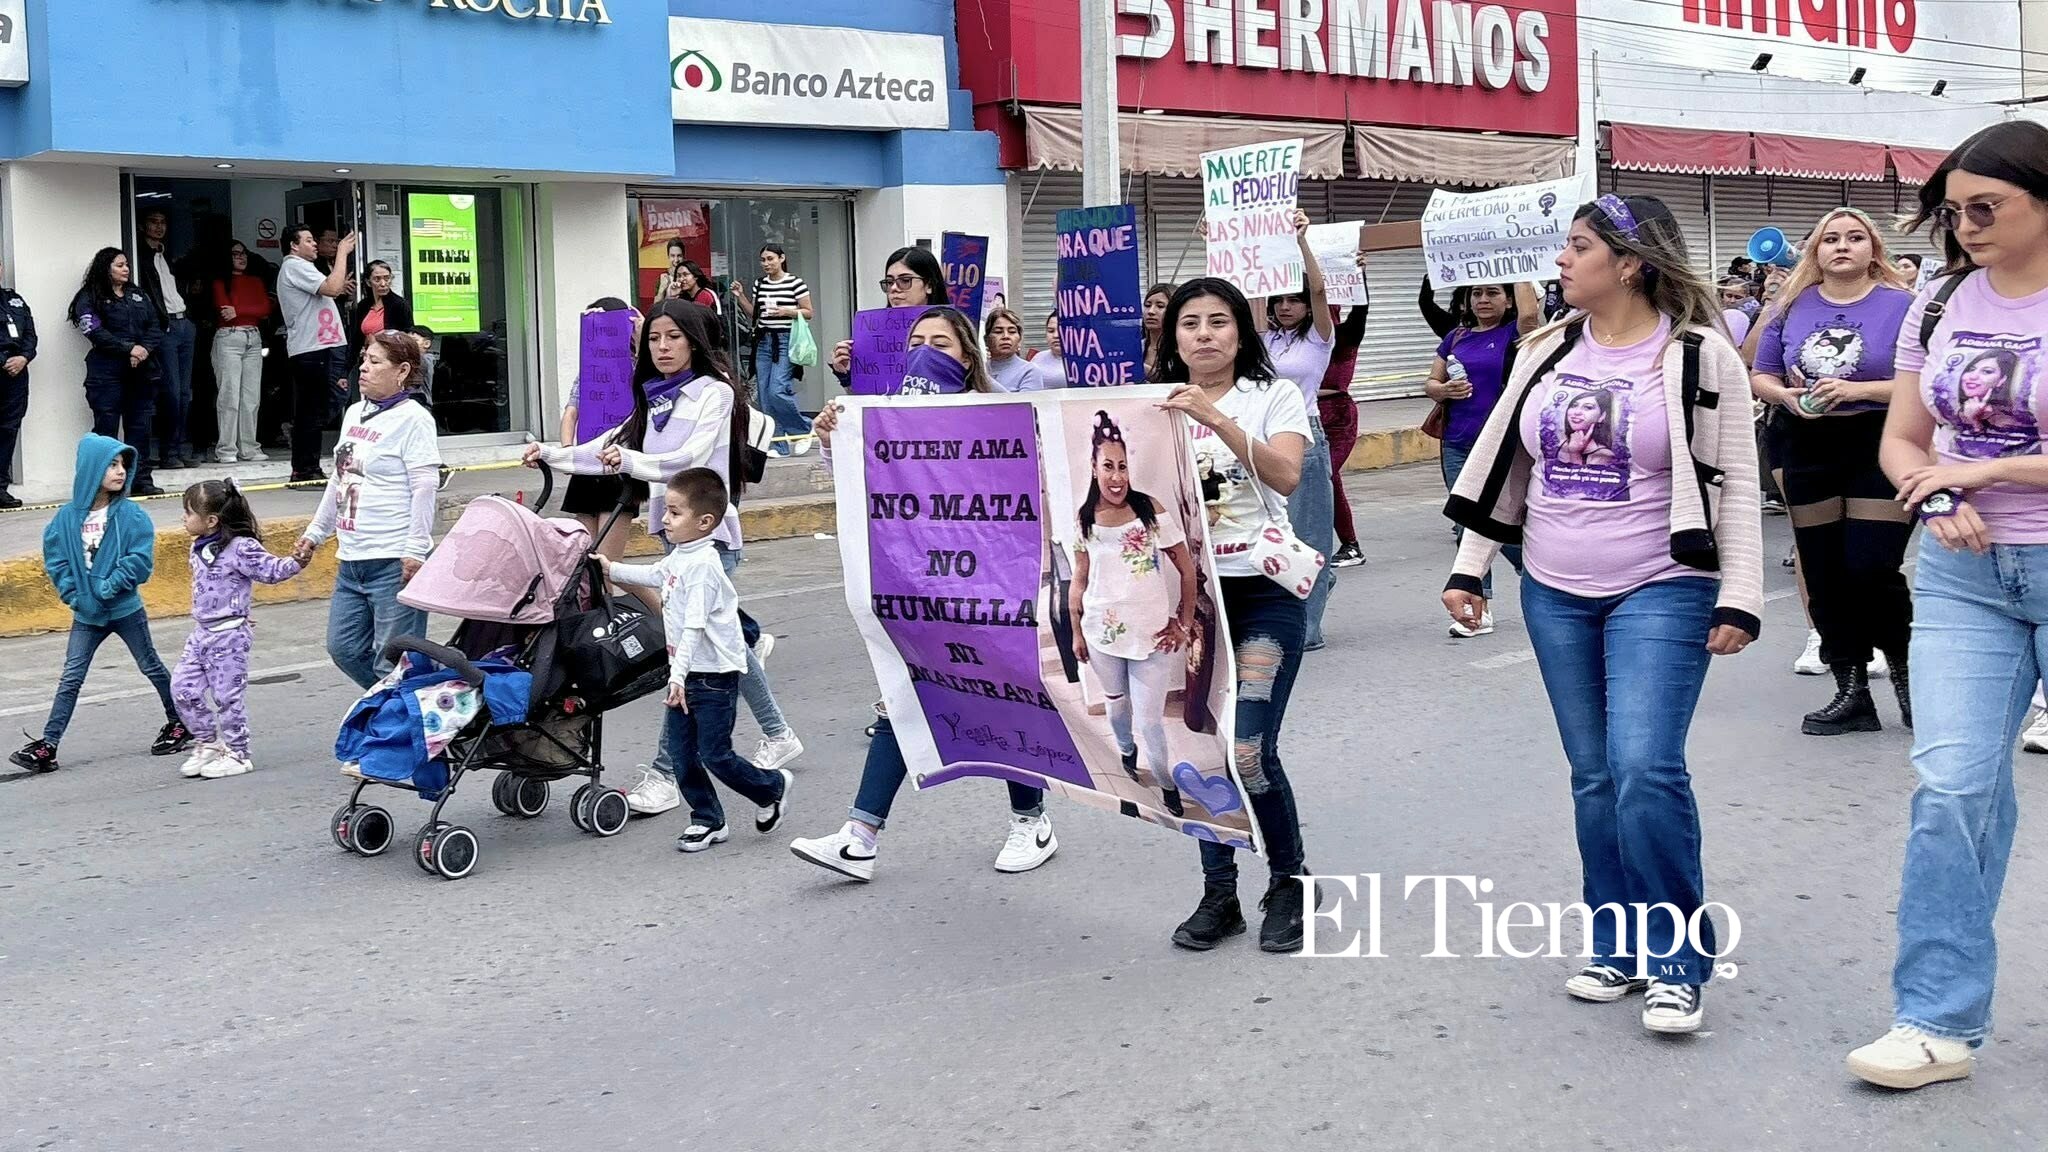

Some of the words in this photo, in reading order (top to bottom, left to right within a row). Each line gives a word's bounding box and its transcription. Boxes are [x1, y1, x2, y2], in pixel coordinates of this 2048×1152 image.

[1184, 0, 1551, 93] HERMANOS
[731, 62, 827, 98] Banco
[834, 69, 935, 102] Azteca
[1206, 146, 1297, 183] MUERTE
[1209, 187, 1229, 207] AL
[1232, 171, 1298, 207] PEDOFILO
[648, 208, 692, 231] PASIÓN
[1519, 203, 1532, 213] DE
[1207, 217, 1240, 243] LAS
[1243, 208, 1295, 239] NIÑAS
[1506, 214, 1560, 238] Social
[1088, 224, 1135, 258] QUE
[1208, 250, 1234, 275] NO
[1241, 245, 1263, 271] SE
[902, 375, 928, 389] POR
[1084, 361, 1136, 387] QUE
[873, 440, 963, 463] QUIEN
[967, 439, 1028, 460] AMA
[870, 493, 921, 519] NO
[929, 494, 1038, 522] MATA
[925, 549, 976, 578] NO
[872, 593, 1038, 628] HUMILLA
[948, 641, 984, 666] NI
[911, 662, 1059, 713] MALTRATA
